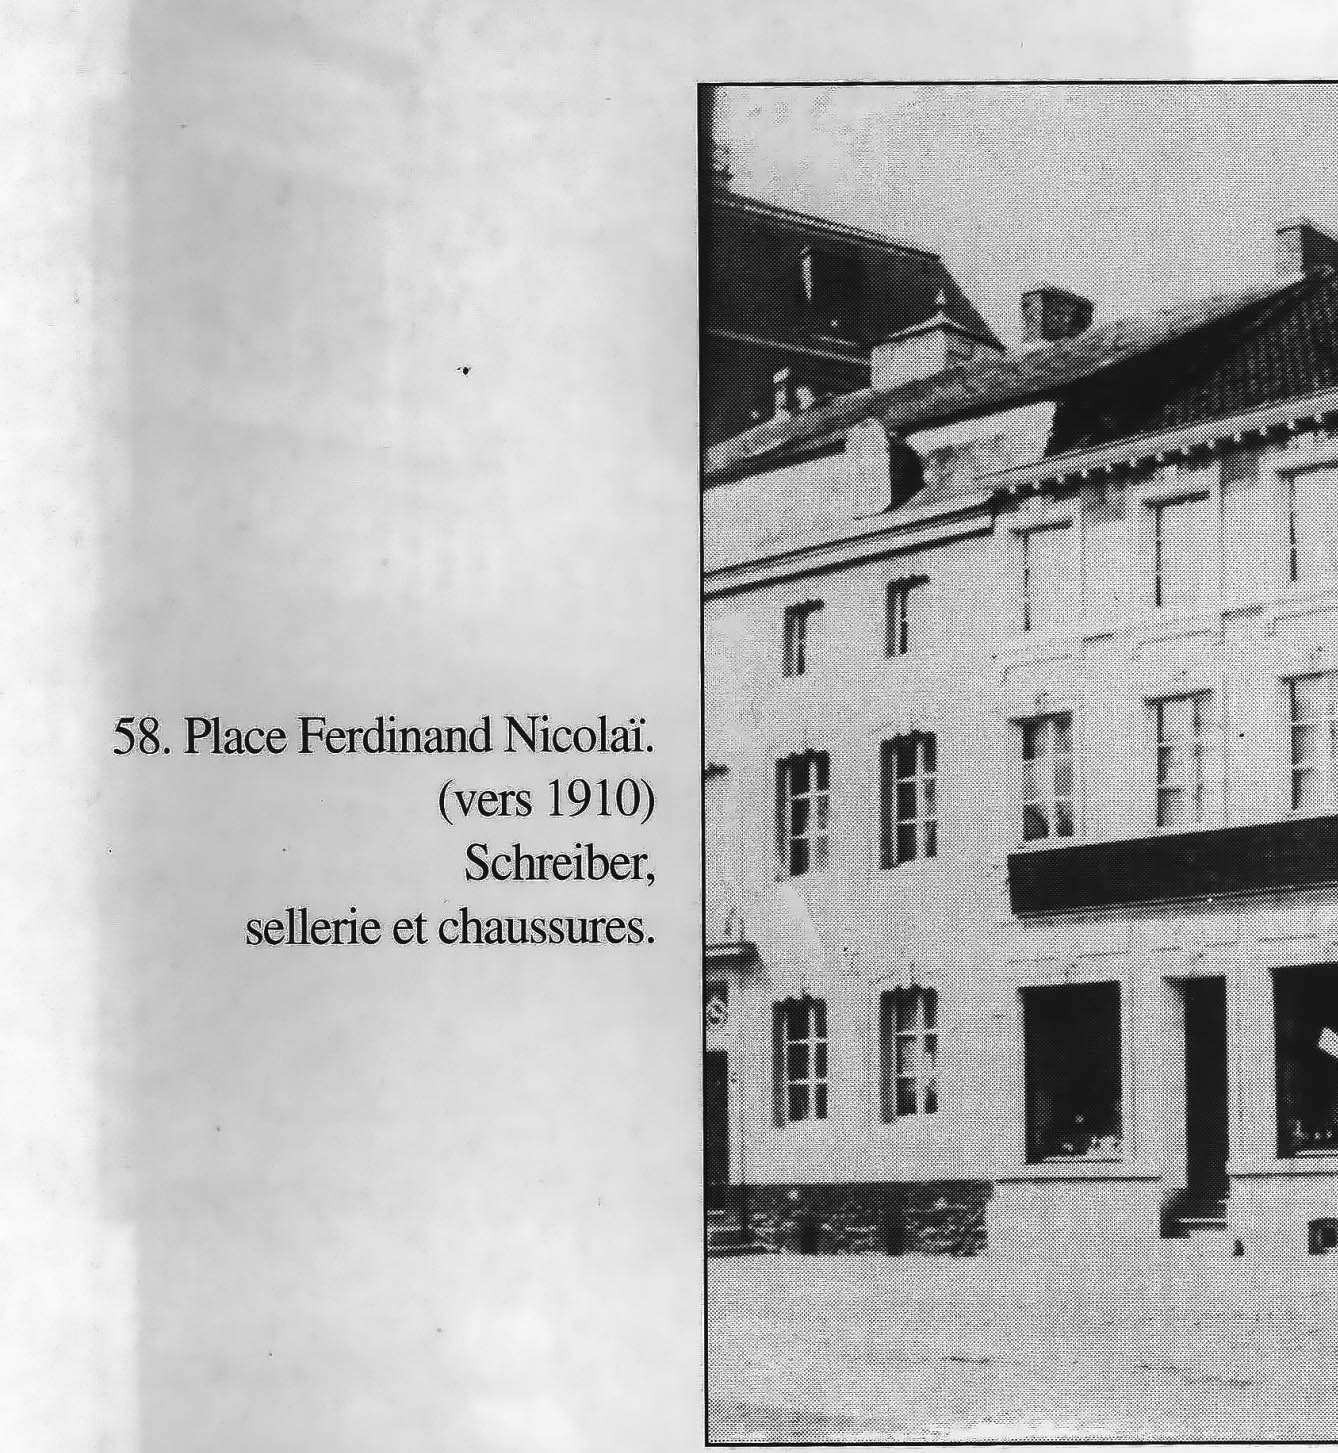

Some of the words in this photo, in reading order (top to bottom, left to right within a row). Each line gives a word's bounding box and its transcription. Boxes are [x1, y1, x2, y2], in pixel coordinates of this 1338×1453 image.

[114, 717, 170, 754] 58.
[184, 717, 287, 754] Place
[298, 716, 493, 753] Ferdinand
[504, 715, 653, 752] Nicolaï.
[439, 780, 532, 825] (vers
[549, 779, 654, 824] 1910)
[466, 843, 654, 886] Schreiber,
[247, 907, 381, 945] sellerie
[393, 913, 428, 944] et
[439, 907, 654, 944] chaussures.
